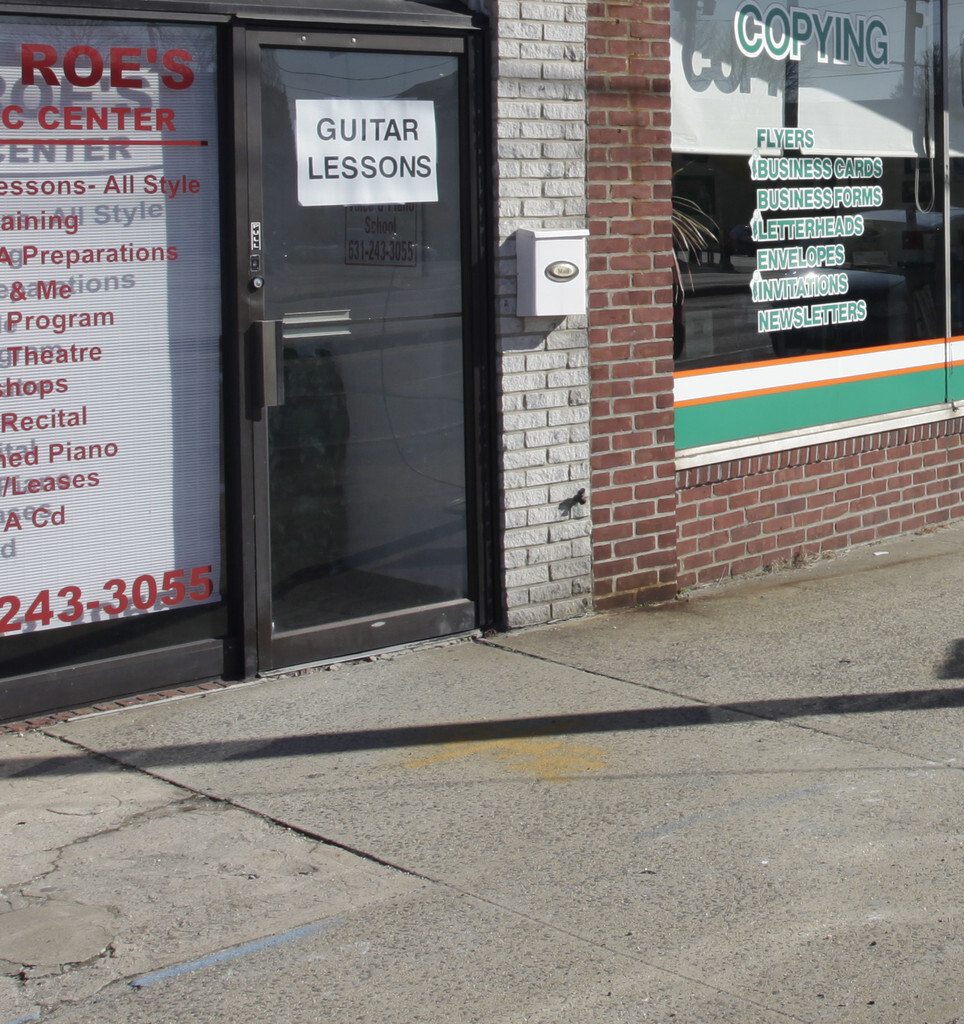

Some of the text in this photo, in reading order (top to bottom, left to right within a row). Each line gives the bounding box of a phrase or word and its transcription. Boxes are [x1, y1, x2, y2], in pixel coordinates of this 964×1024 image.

[735, 1, 889, 68] COPYING
[21, 43, 195, 90] ROE'S
[37, 106, 177, 132] CENTER
[316, 117, 419, 142] GUITAR
[756, 128, 815, 149] FLYERS
[308, 154, 432, 181] LESSONS
[757, 158, 883, 180] BUSINESS CARDS
[103, 175, 134, 195] All
[143, 174, 200, 199] Style
[757, 186, 883, 211] BUSINESS FORMS
[1, 210, 79, 235] aining
[365, 216, 397, 235] School
[758, 215, 864, 241] LETTERHEADS
[22, 242, 179, 269] Preparations
[349, 238, 414, 262] 631-243-3055
[757, 244, 845, 271] ENVELOPES
[9, 280, 72, 301] & Me
[758, 273, 849, 302] INVITATIONS
[7, 309, 115, 334] Program
[758, 300, 868, 333] NEWSLETTERS
[7, 345, 102, 367] Theatre
[0, 377, 68, 399] hops
[1, 406, 88, 433] Recital
[49, 442, 119, 466] Piano
[3, 472, 100, 497] /Leases
[5, 506, 66, 532] A Cd
[0, 565, 214, 634] 243-3055
